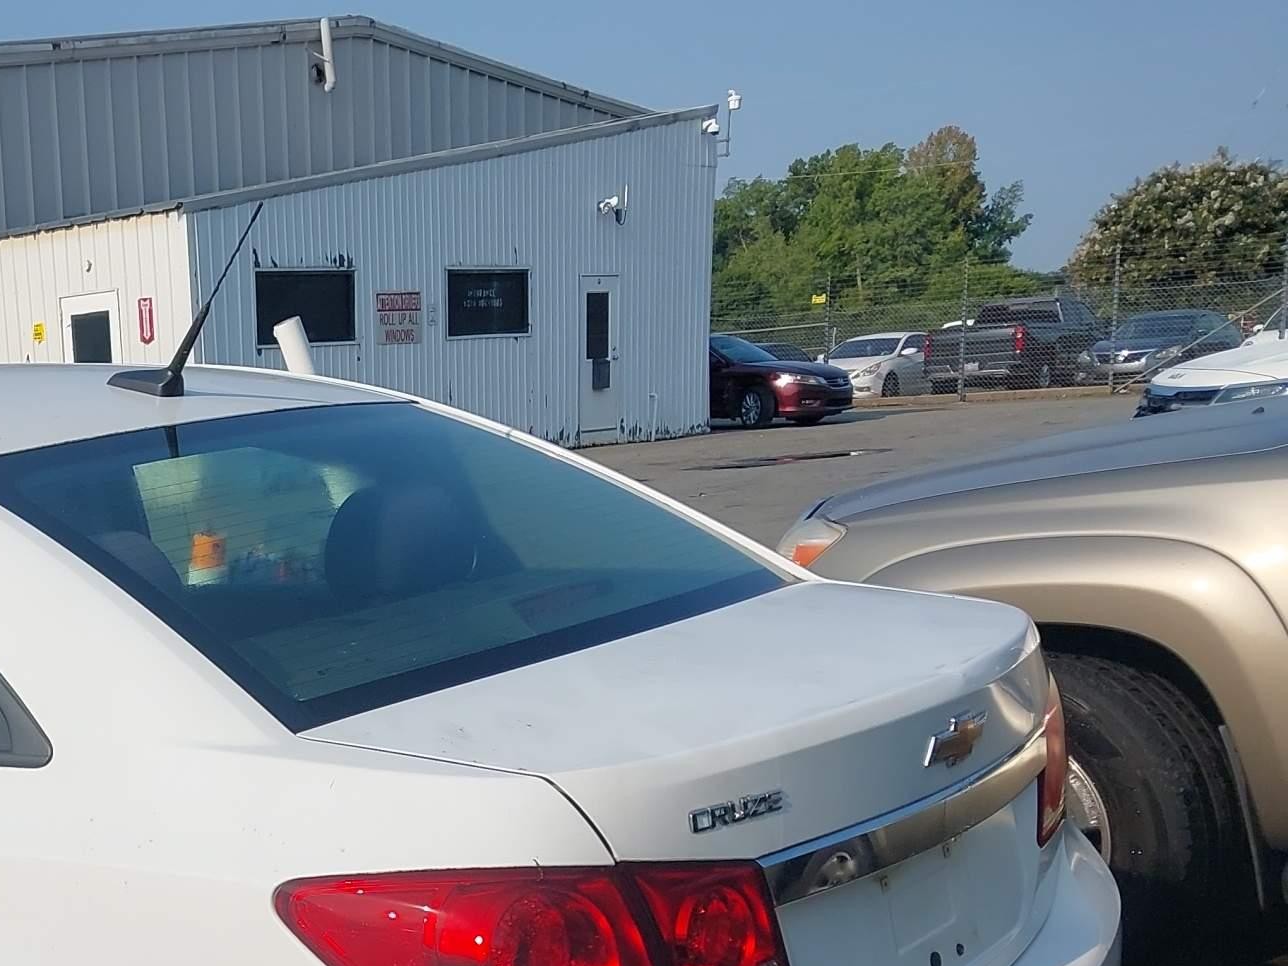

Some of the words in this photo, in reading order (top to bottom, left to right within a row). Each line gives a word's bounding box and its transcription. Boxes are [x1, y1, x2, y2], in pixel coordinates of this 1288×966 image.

[379, 313, 395, 325] ROLL
[398, 312, 406, 325] UP
[408, 312, 419, 325] ALL
[385, 329, 414, 342] WINDOWS
[688, 789, 783, 834] CRUZE
